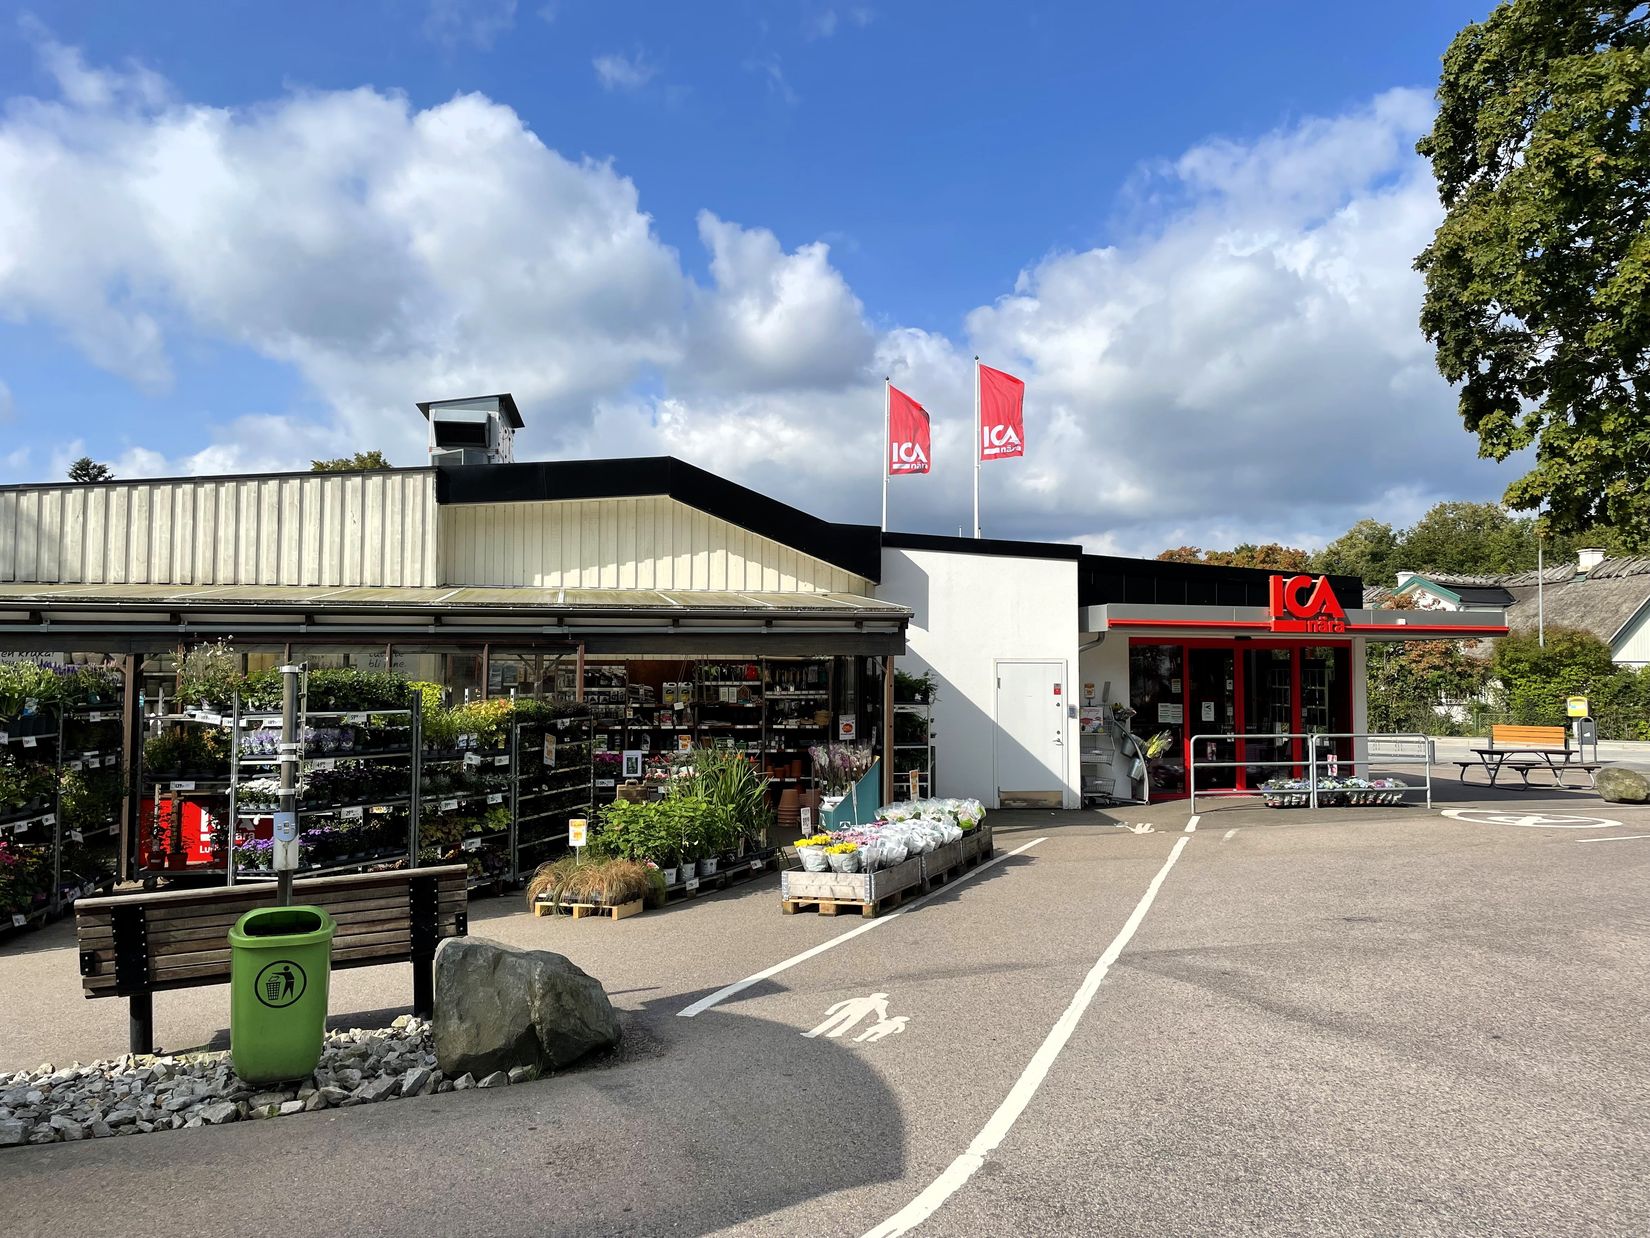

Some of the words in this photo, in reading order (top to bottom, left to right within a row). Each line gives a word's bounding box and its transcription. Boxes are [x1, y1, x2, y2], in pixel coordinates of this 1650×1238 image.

[983, 424, 1021, 446] ICA
[892, 441, 928, 463] ICA
[1269, 574, 1346, 619] ICA
[1307, 616, 1345, 633] nära
